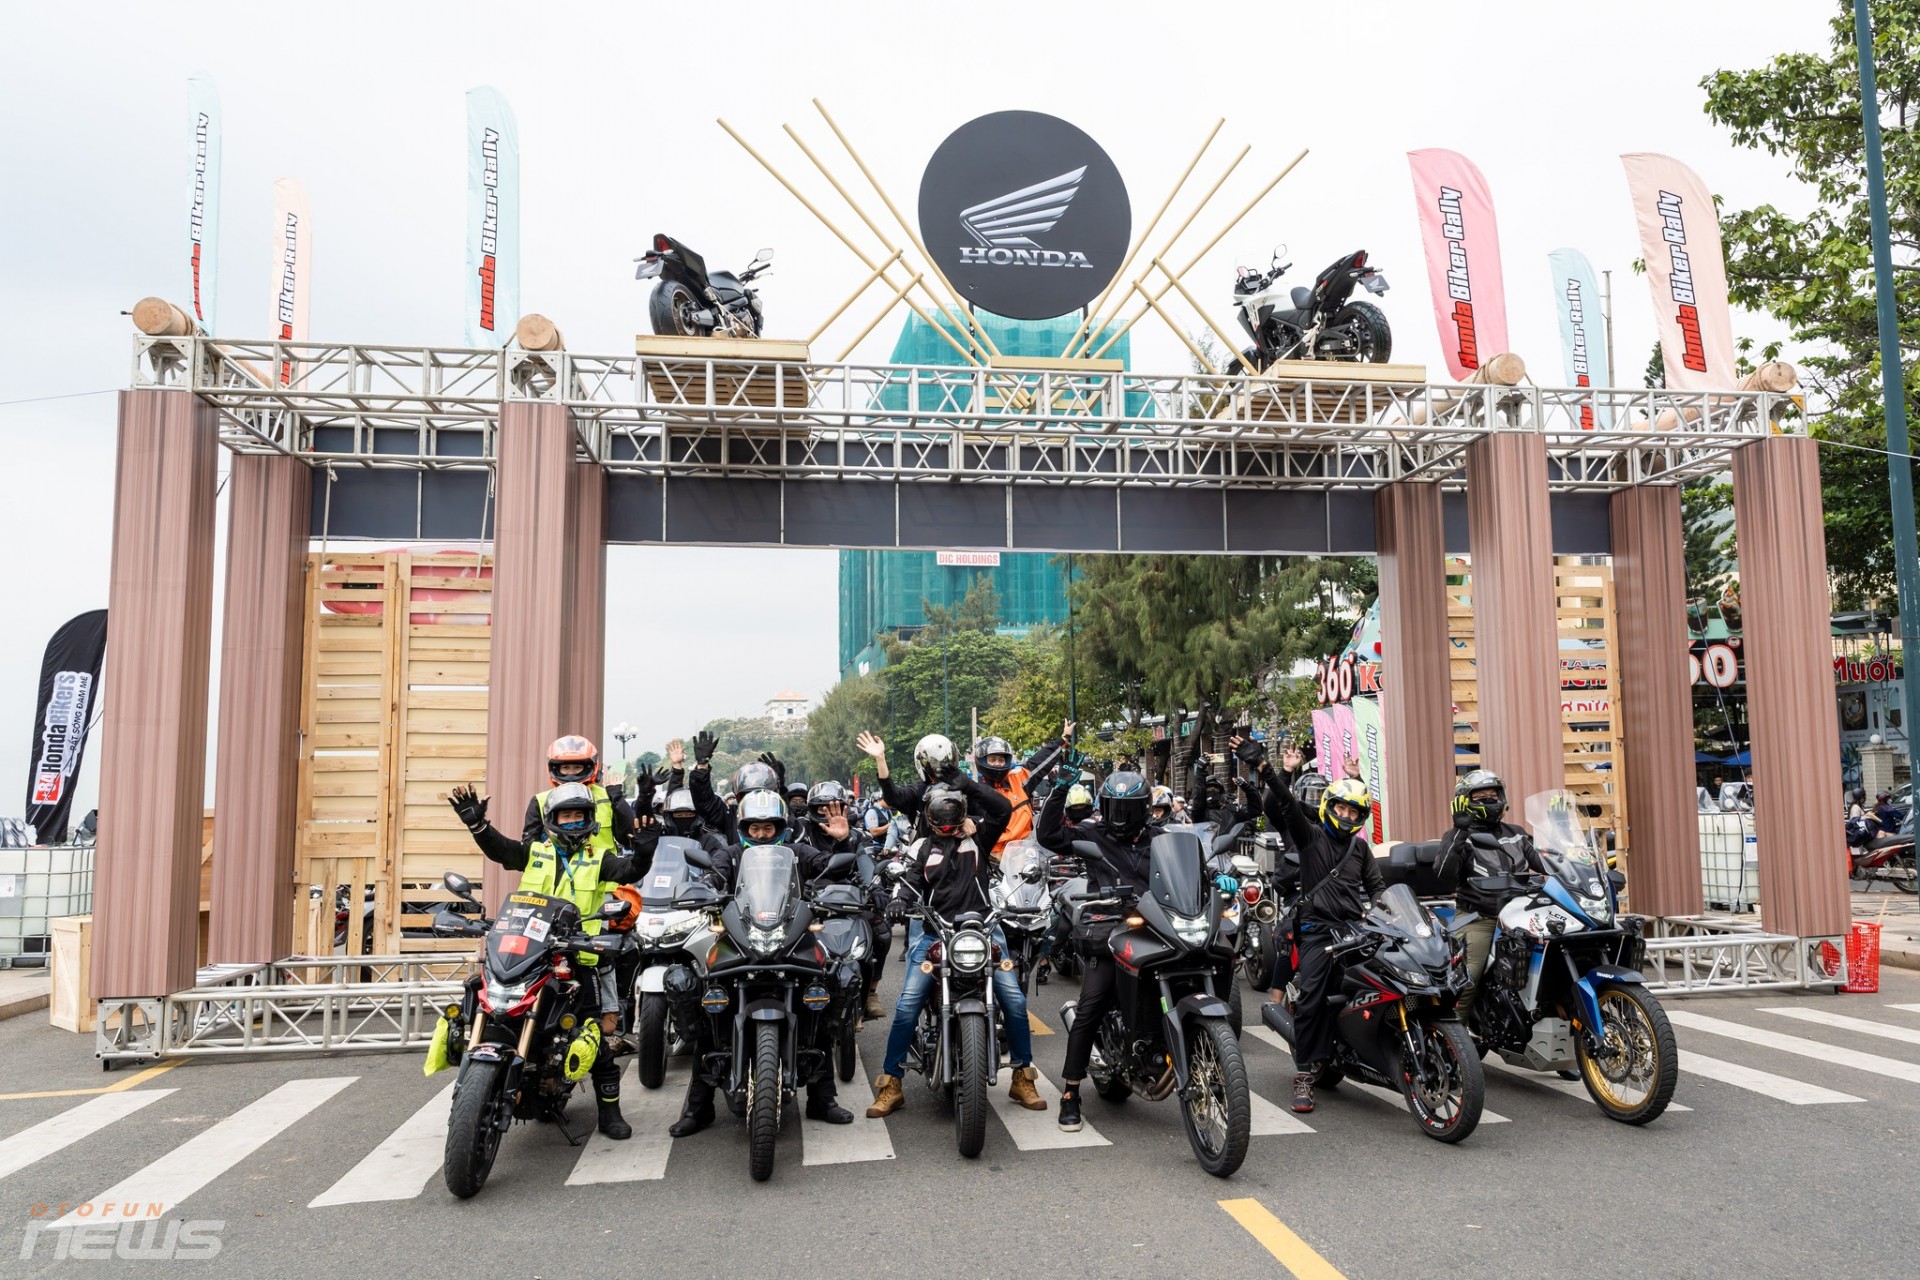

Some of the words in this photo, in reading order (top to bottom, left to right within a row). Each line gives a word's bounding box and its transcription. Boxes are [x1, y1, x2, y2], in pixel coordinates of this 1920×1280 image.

[196, 112, 209, 173] Rally
[482, 127, 499, 188] Rally
[191, 173, 205, 242] Biker
[481, 187, 498, 255] Biker
[1438, 185, 1465, 241] Rally
[1656, 189, 1686, 245] Rally
[284, 213, 298, 265] Rally
[959, 246, 1094, 269] HONDA
[191, 242, 203, 321] Honda
[278, 264, 296, 325] Biker
[478, 254, 496, 332] Honda
[1446, 240, 1472, 302] Biker
[1566, 278, 1583, 323] Rally
[1669, 244, 1696, 306] Biker
[1451, 300, 1480, 371] Honda
[1573, 323, 1588, 374] Biker
[1676, 303, 1707, 373] Honda
[939, 554, 954, 564] DIC
[956, 554, 999, 565] HOLDINGS
[1366, 724, 1378, 761] Rally
